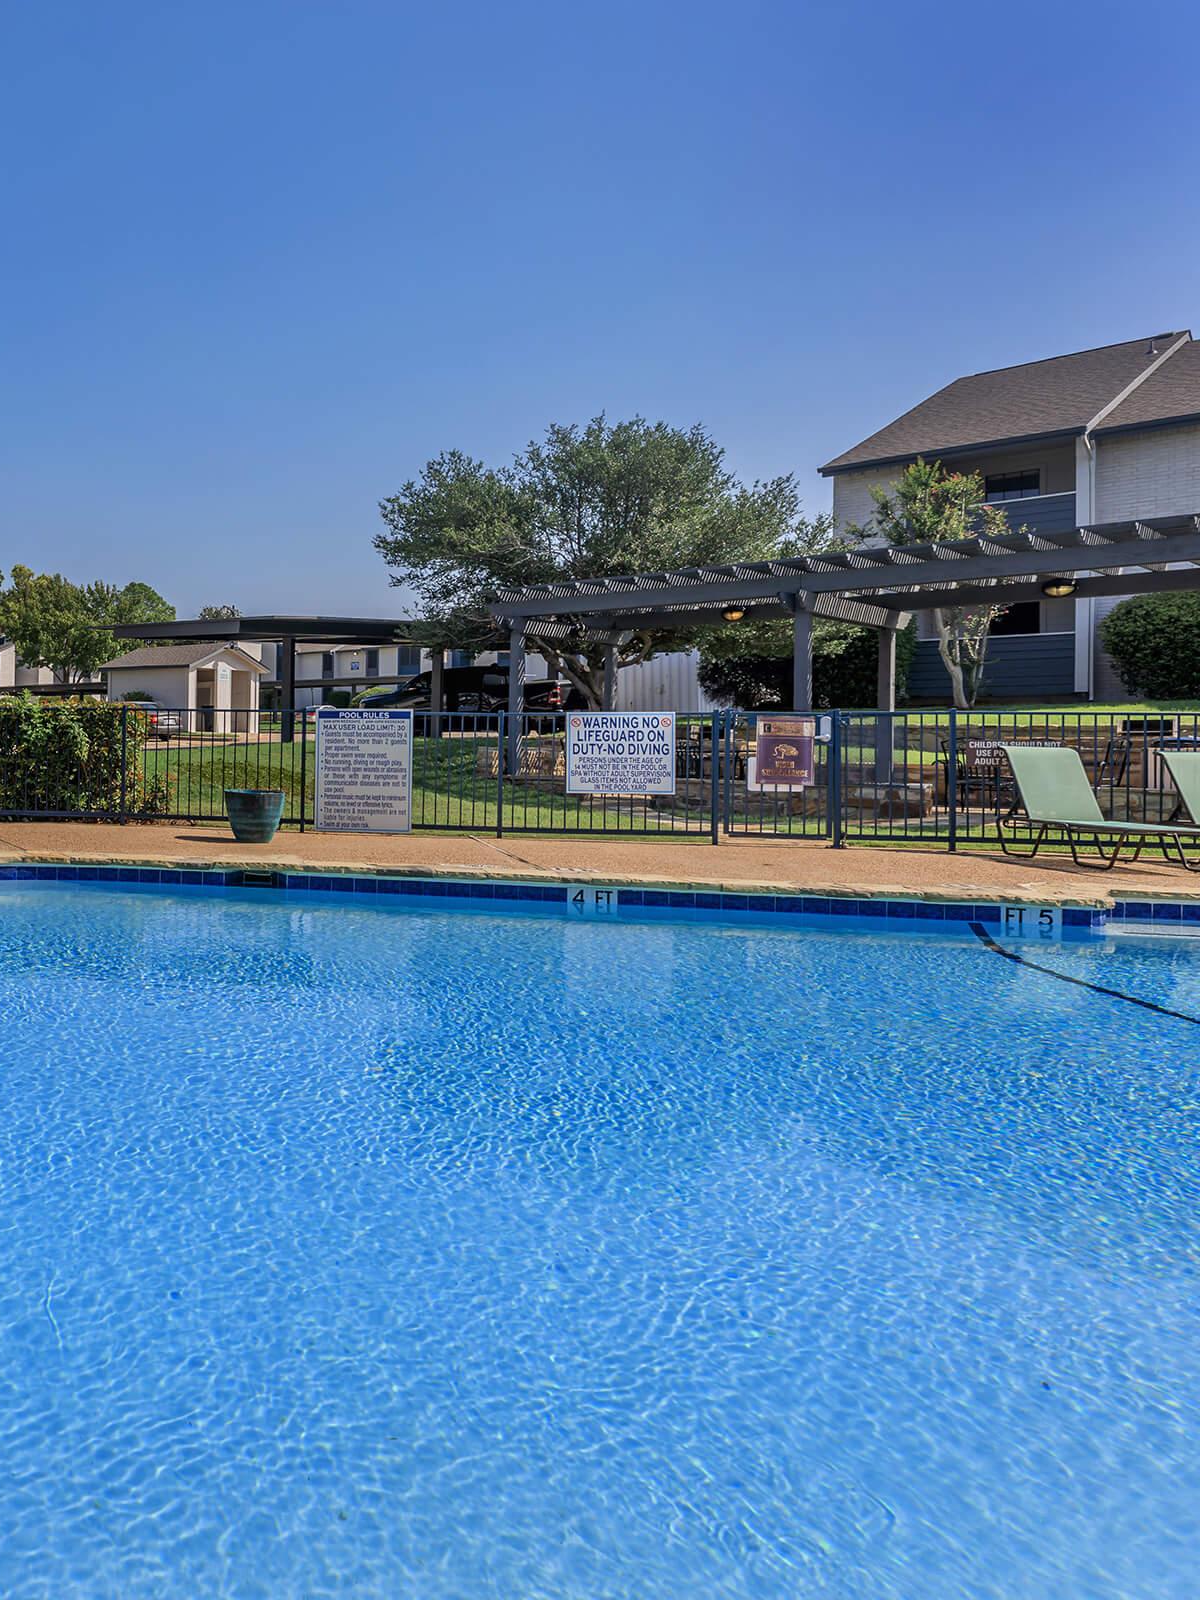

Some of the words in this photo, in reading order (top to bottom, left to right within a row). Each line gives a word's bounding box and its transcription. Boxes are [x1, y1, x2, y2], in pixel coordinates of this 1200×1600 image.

[582, 717, 639, 728] WARNING
[642, 717, 659, 728] NO
[577, 730, 644, 742] LIFEGUARD
[647, 730, 664, 742] ON
[573, 744, 625, 755] DUTY-NO
[628, 744, 670, 755] DIVING
[572, 889, 584, 902] 4
[595, 890, 613, 904] FT
[1006, 907, 1026, 923] FT
[1039, 910, 1053, 925] 5
